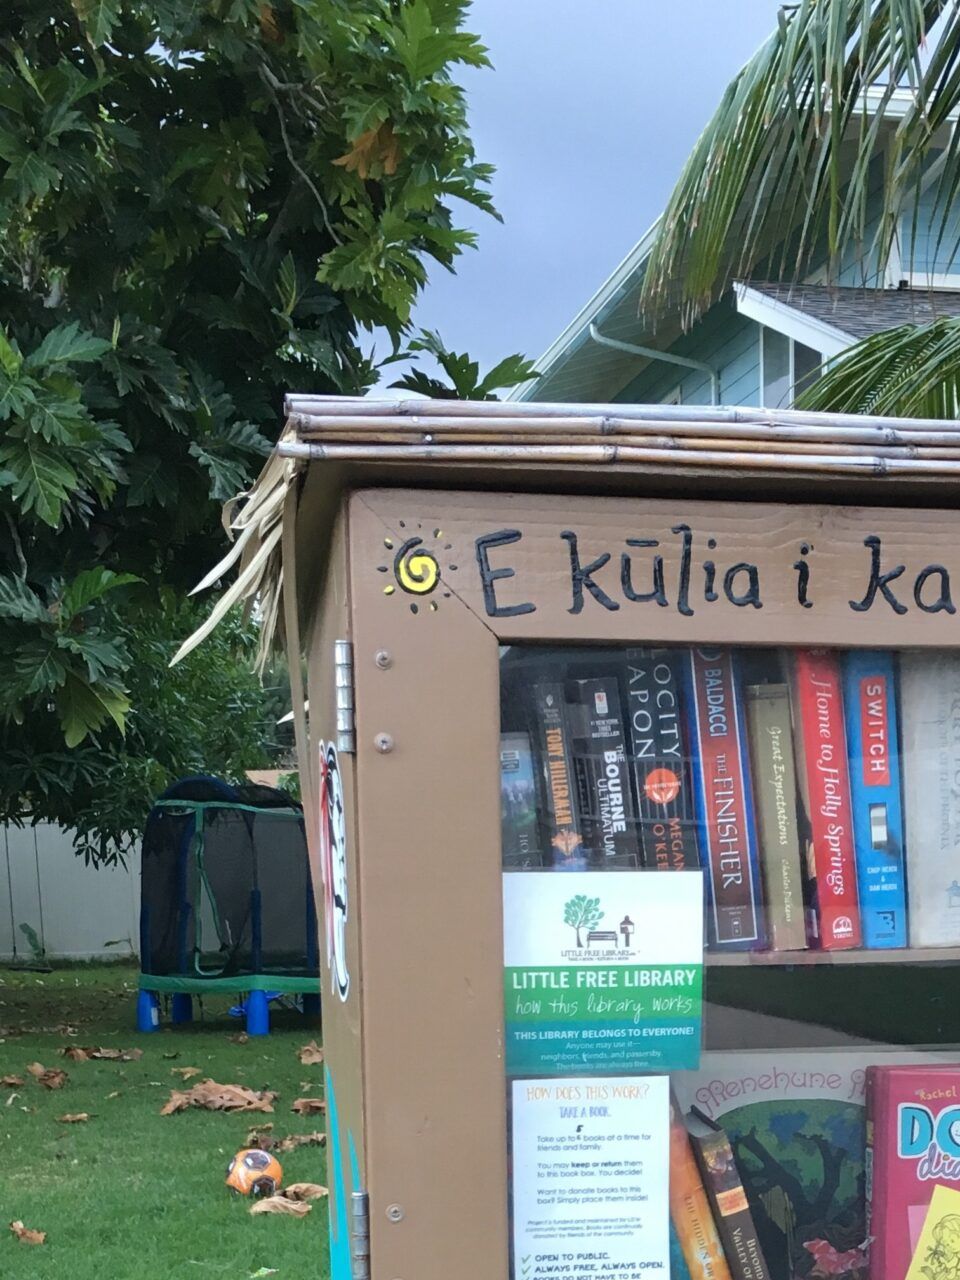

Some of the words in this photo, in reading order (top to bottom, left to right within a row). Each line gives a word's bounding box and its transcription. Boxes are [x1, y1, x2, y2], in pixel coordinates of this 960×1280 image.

[476, 529, 535, 617] E
[561, 524, 763, 616] kūlia
[796, 544, 814, 609] i
[849, 536, 956, 616] ka
[626, 648, 656, 759] EAPON
[651, 648, 682, 758] LOCITY
[704, 668, 728, 737] BALDACCI
[809, 673, 832, 738] Home
[546, 727, 564, 756] TONY
[766, 726, 783, 761] Great
[866, 685, 886, 772] SWITCH
[616, 744, 625, 762] THE
[716, 753, 727, 773] THE
[821, 744, 834, 761] to
[604, 751, 626, 833] BOURNE
[769, 764, 789, 845] Expectations
[817, 759, 842, 818] Holly
[597, 778, 616, 856] ULTIMATUM
[713, 776, 743, 889] FINISHER
[653, 823, 668, 872] O'KEE
[824, 823, 846, 895] Springs
[513, 972, 570, 989] LITTLE
[577, 970, 618, 988] FREE
[625, 969, 696, 986] LIBRARY
[515, 996, 541, 1014] how
[550, 994, 578, 1016] this
[587, 993, 644, 1024] library
[652, 995, 692, 1014] works
[514, 1031, 537, 1040] THIS
[539, 1030, 579, 1039] LIBRARY
[582, 1028, 626, 1038] BELONGS
[628, 1028, 641, 1037] TO
[642, 1026, 695, 1037] EVERYONE!
[566, 1042, 594, 1050] Anyone
[596, 1042, 612, 1050] may
[526, 1087, 551, 1101] HOW
[555, 1086, 581, 1100] DOES
[586, 1085, 608, 1100] THIS
[612, 1084, 650, 1100] WORK?
[696, 1066, 842, 1117] Menehune
[920, 1085, 957, 1101] Rachel
[560, 1106, 579, 1118] TAKE
[581, 1106, 587, 1118] A
[537, 1135, 554, 1143] Take
[571, 1161, 590, 1169] keep
[535, 1254, 559, 1262] OPEN
[562, 1253, 574, 1261] TO
[535, 1265, 570, 1273] ALWAYS
[601, 1262, 636, 1270] ALWAYS
[639, 1261, 665, 1269] OPEN.
[733, 1227, 748, 1264] VALLEY
[743, 1267, 753, 1279] OF
[747, 1238, 764, 1280] BEYOND
